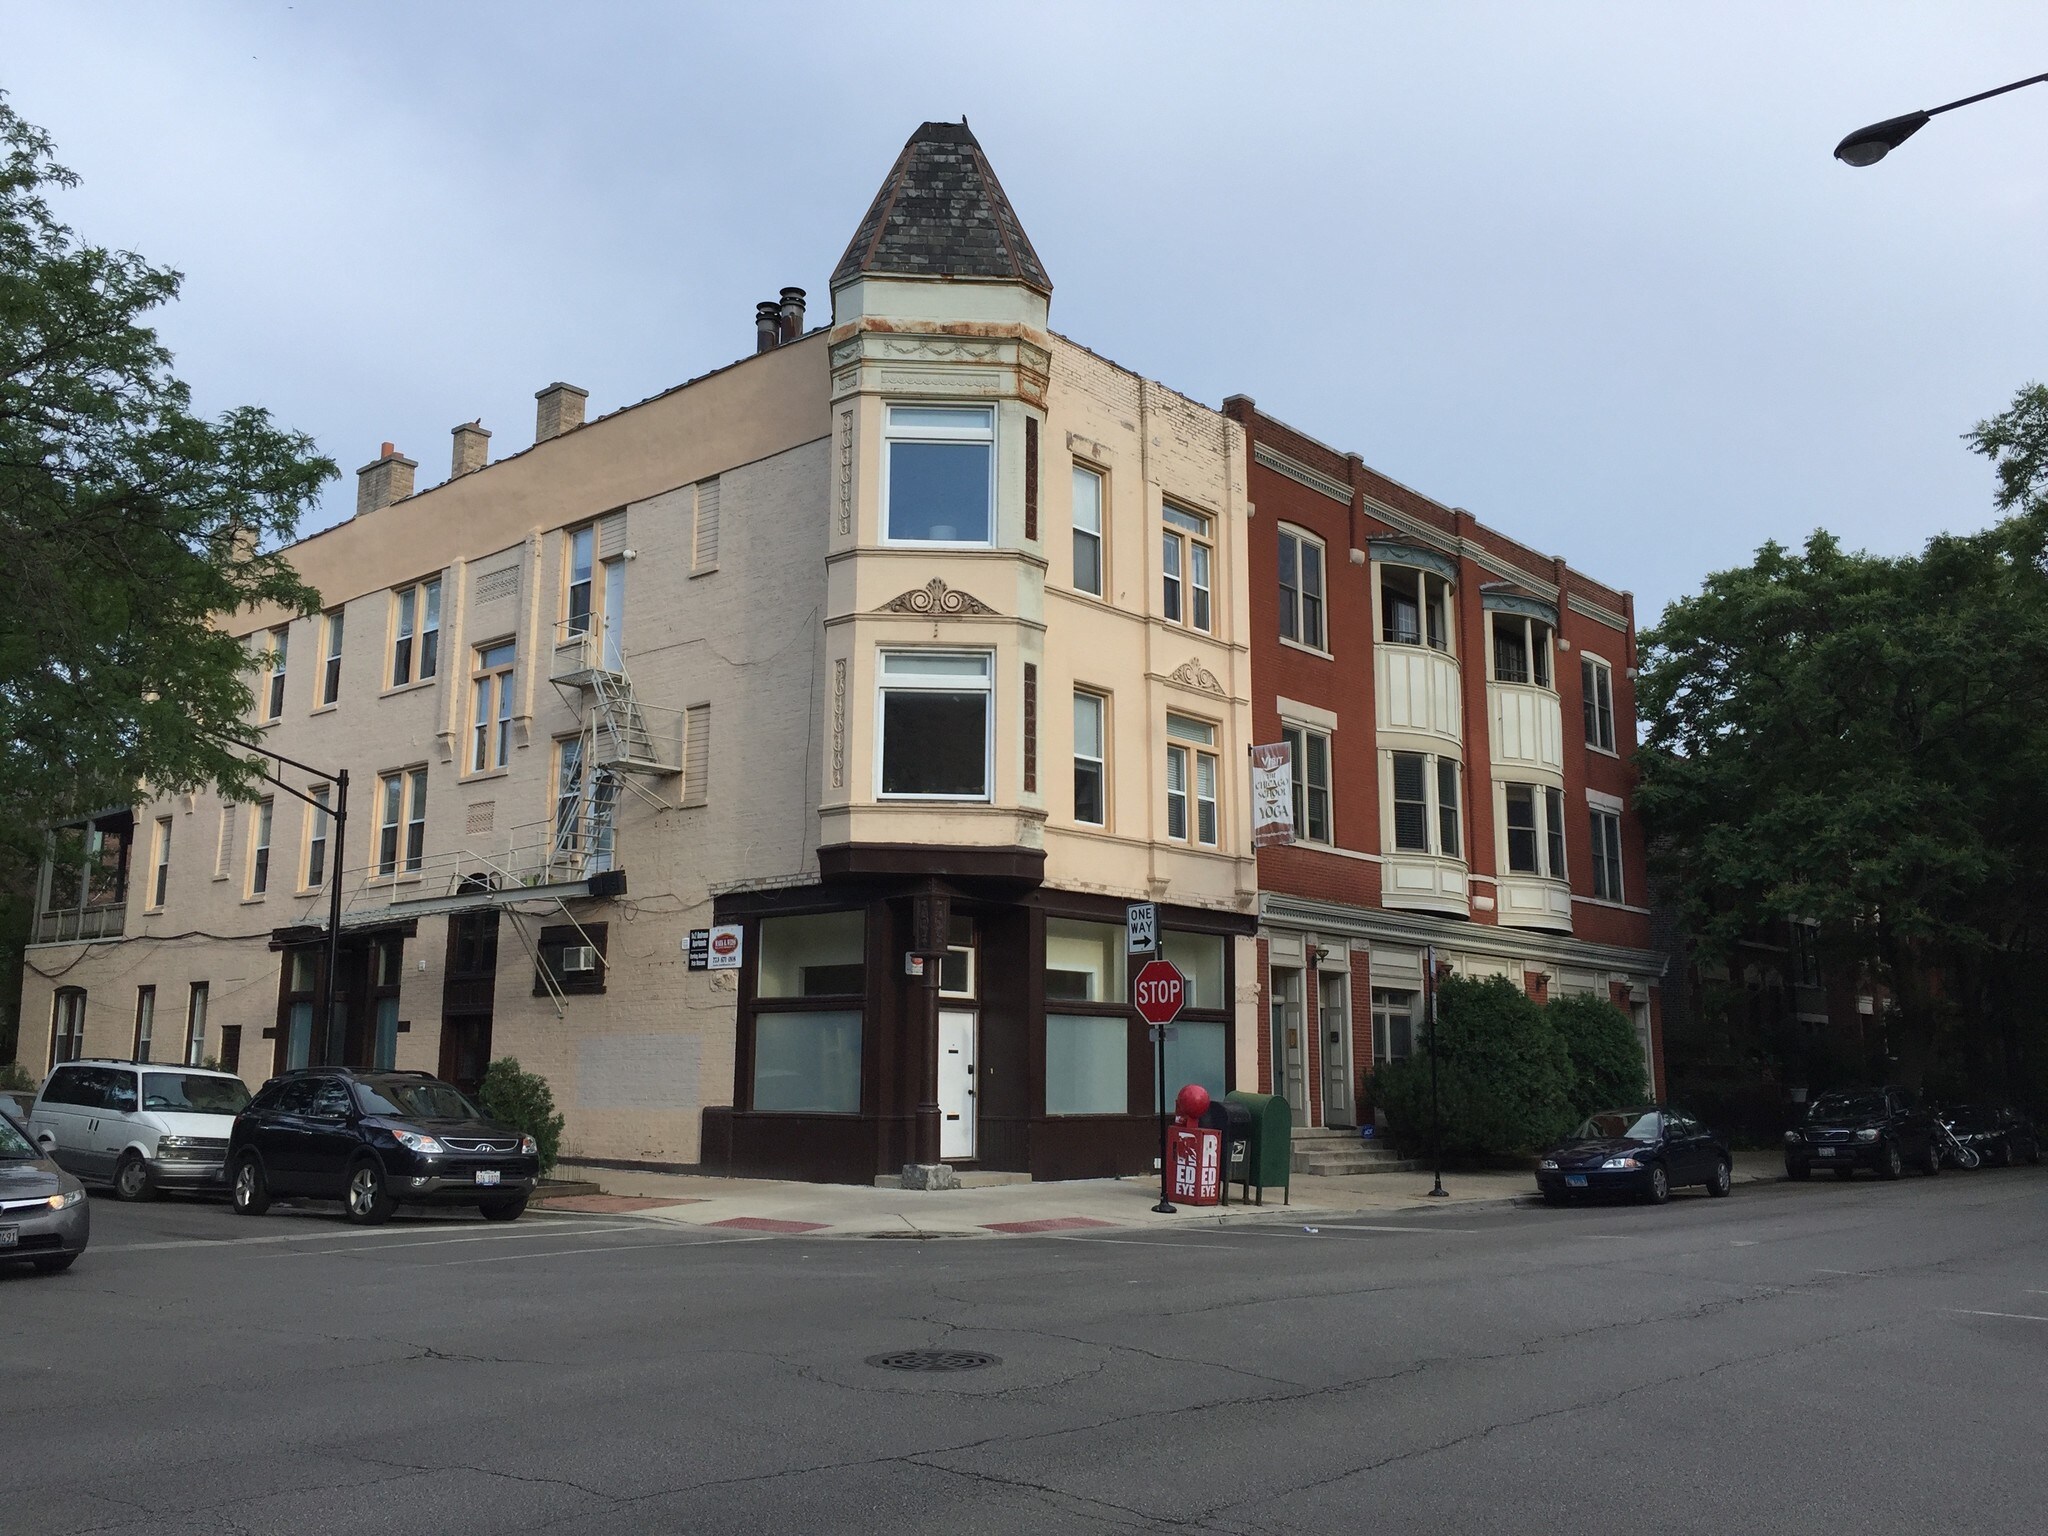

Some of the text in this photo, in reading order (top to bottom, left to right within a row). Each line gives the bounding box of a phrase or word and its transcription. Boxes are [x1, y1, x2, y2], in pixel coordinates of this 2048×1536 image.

[1261, 756, 1283, 768] VISIT
[1255, 778, 1288, 790] CHICAGO
[1259, 805, 1288, 819] YOGA
[1130, 908, 1152, 920] ONE
[1130, 921, 1152, 934] WAY
[1138, 980, 1180, 1004] STOP
[1176, 1182, 1195, 1196] EYE
[1201, 1185, 1215, 1197] EYE
